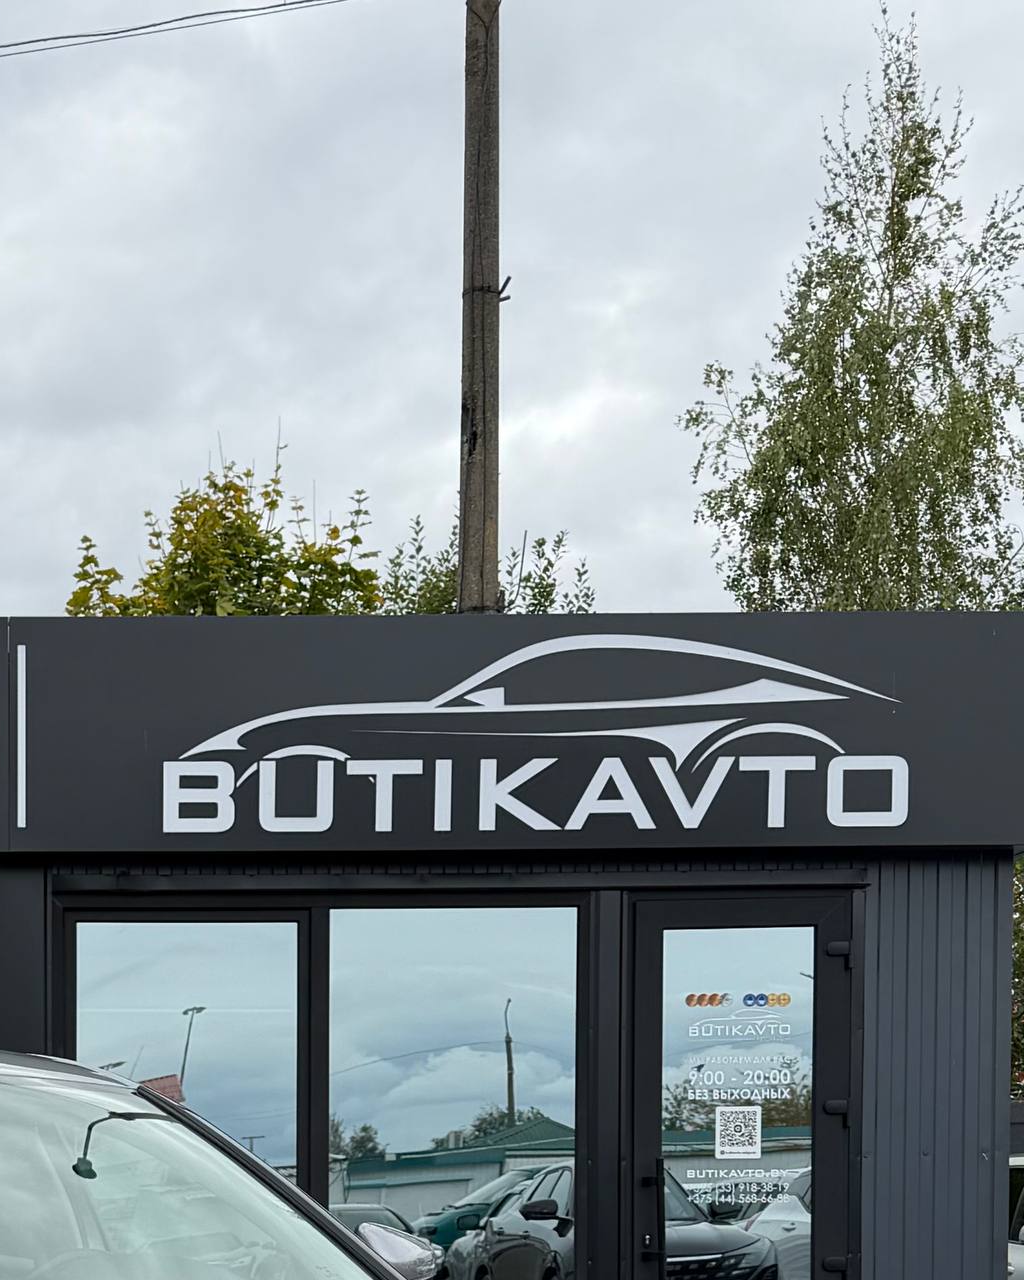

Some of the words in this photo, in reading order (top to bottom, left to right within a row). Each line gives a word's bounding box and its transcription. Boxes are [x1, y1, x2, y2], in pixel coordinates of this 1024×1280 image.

[162, 755, 909, 833] BUTIKAVTO
[689, 1024, 791, 1037] BUTIKAVTO
[688, 1070, 724, 1085] 9:00
[743, 1070, 791, 1085] 20:00
[687, 1088, 709, 1100] БЕЗ
[712, 1088, 791, 1101] ВЫХОДНЫХ
[686, 1168, 787, 1178] BUTIKAVTO.BY
[715, 1182, 735, 1195] (33)
[738, 1183, 790, 1193] 918-38-19
[687, 1194, 712, 1204] +375
[715, 1194, 735, 1206] (44)
